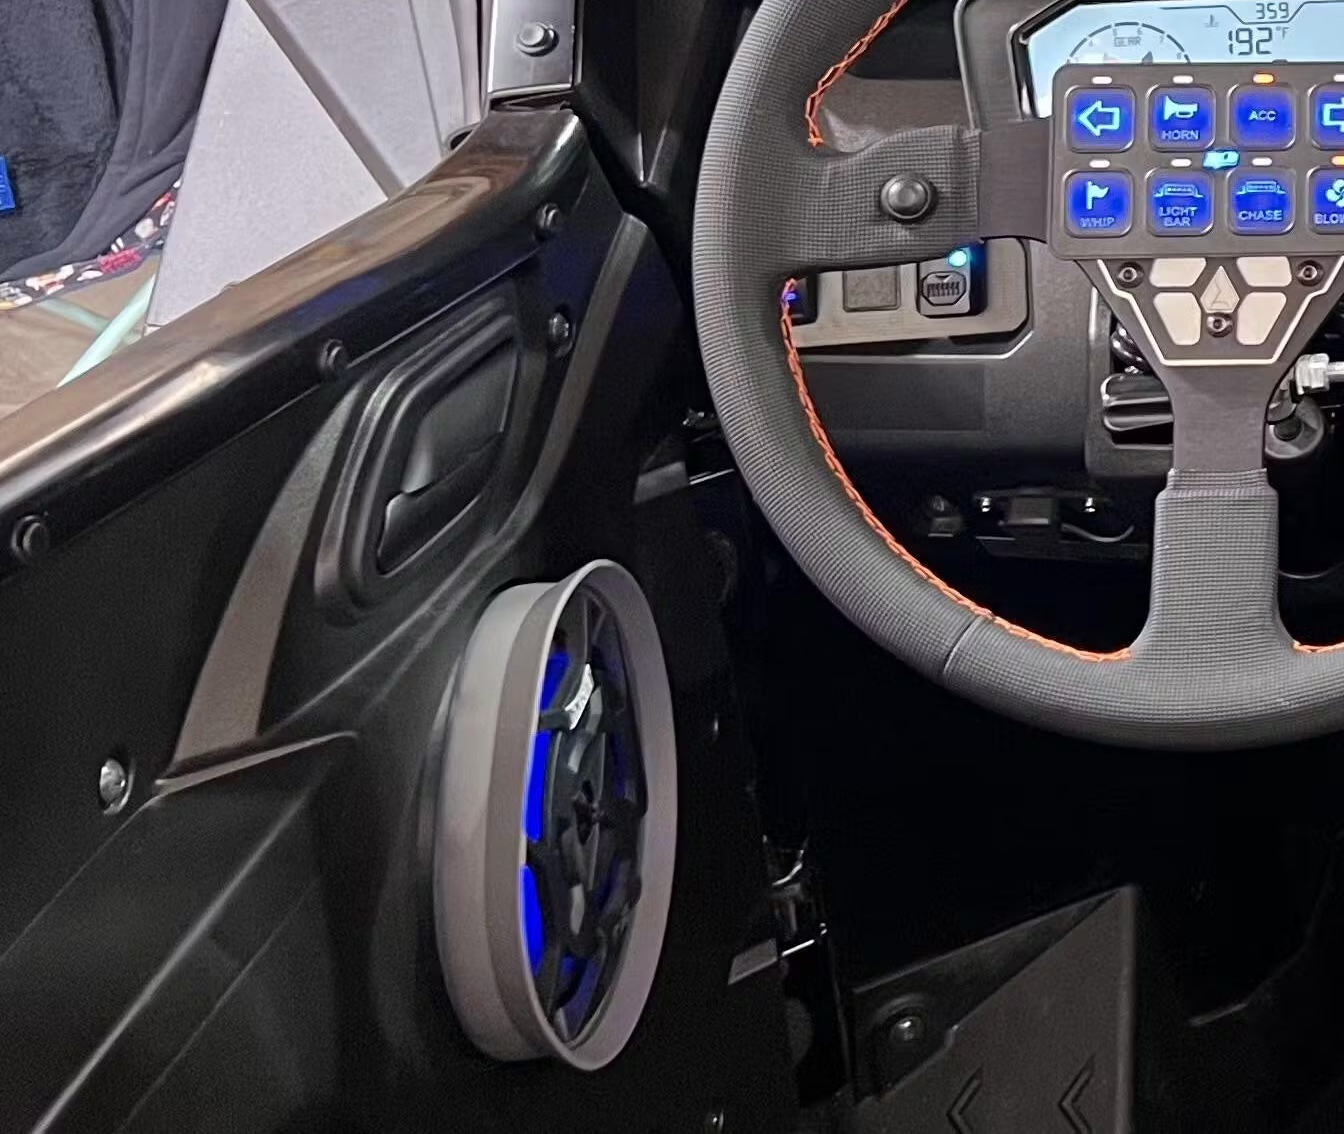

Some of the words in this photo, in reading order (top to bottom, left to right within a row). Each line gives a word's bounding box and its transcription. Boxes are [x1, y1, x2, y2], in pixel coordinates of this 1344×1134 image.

[1256, 2, 1289, 19] 359
[1228, 27, 1272, 56] 192
[1248, 110, 1276, 121] ACC
[1162, 130, 1199, 140] HORN
[1160, 206, 1198, 217] LIGHT
[1238, 210, 1282, 221] CHASE
[1080, 217, 1114, 228] WHIP
[1164, 216, 1191, 228] BAR
